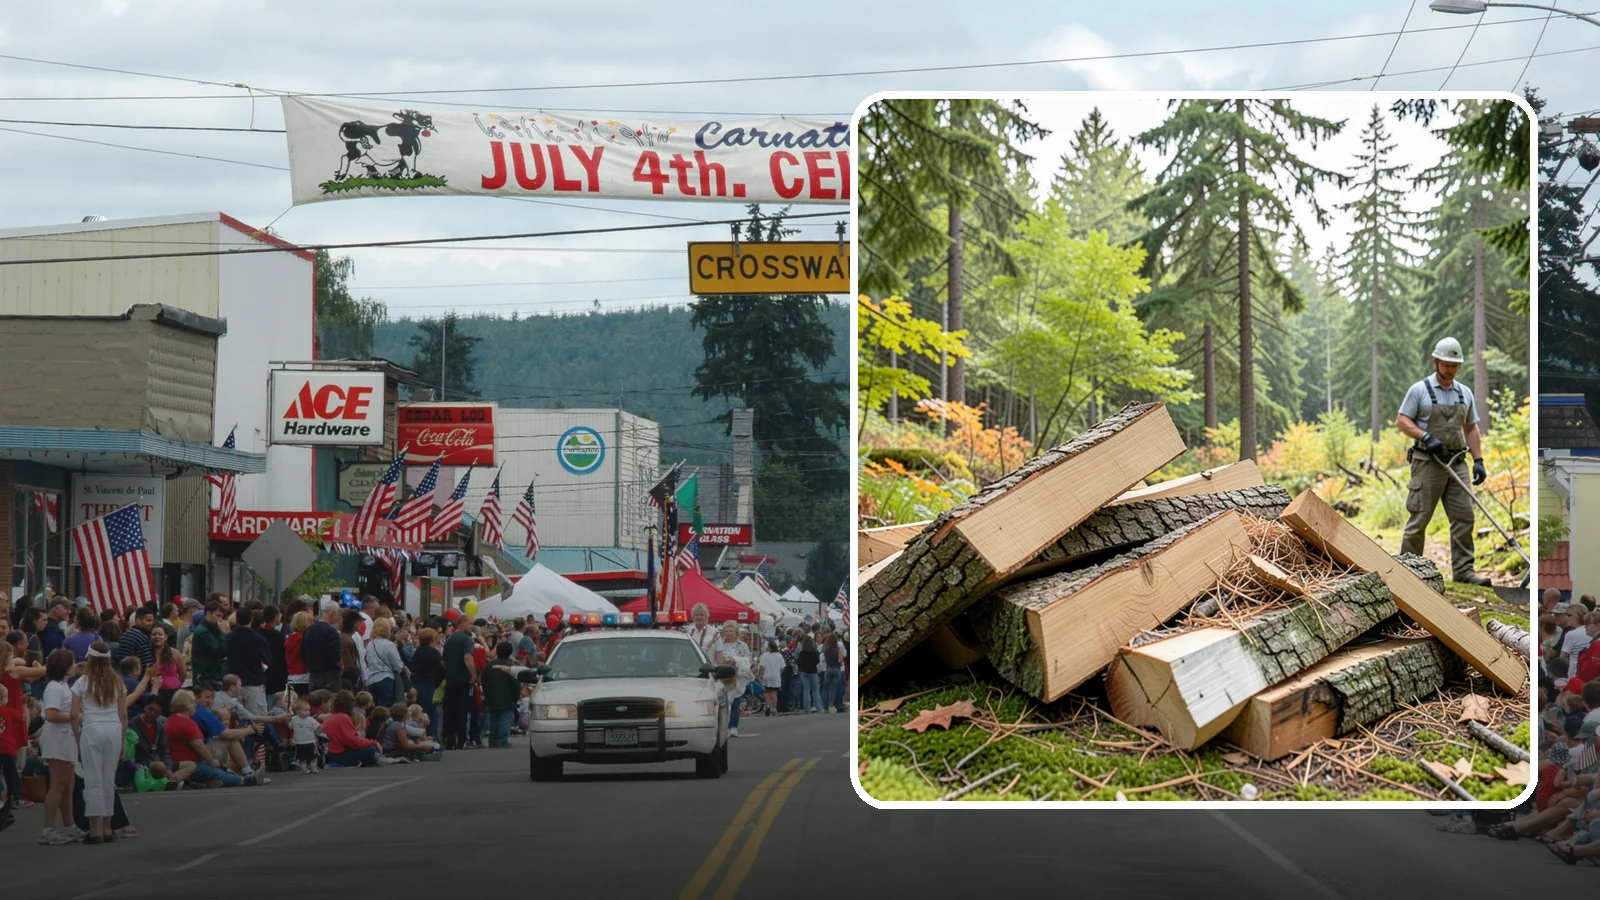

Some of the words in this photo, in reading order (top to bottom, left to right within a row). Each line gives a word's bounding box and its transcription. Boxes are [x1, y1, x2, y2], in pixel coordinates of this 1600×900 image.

[695, 121, 850, 150] Carnat
[481, 141, 605, 192] JULY
[632, 150, 746, 198] 4th.
[697, 254, 850, 280] CROSSWA
[282, 380, 373, 420] ACE
[406, 409, 452, 422] CEDAR
[461, 409, 485, 421] LOG
[283, 421, 370, 436] Hardware
[95, 485, 125, 495] Vincent
[126, 486, 136, 495] de
[138, 486, 155, 495] Paul
[688, 526, 741, 535] CRNATION
[699, 535, 729, 543] GLASS
